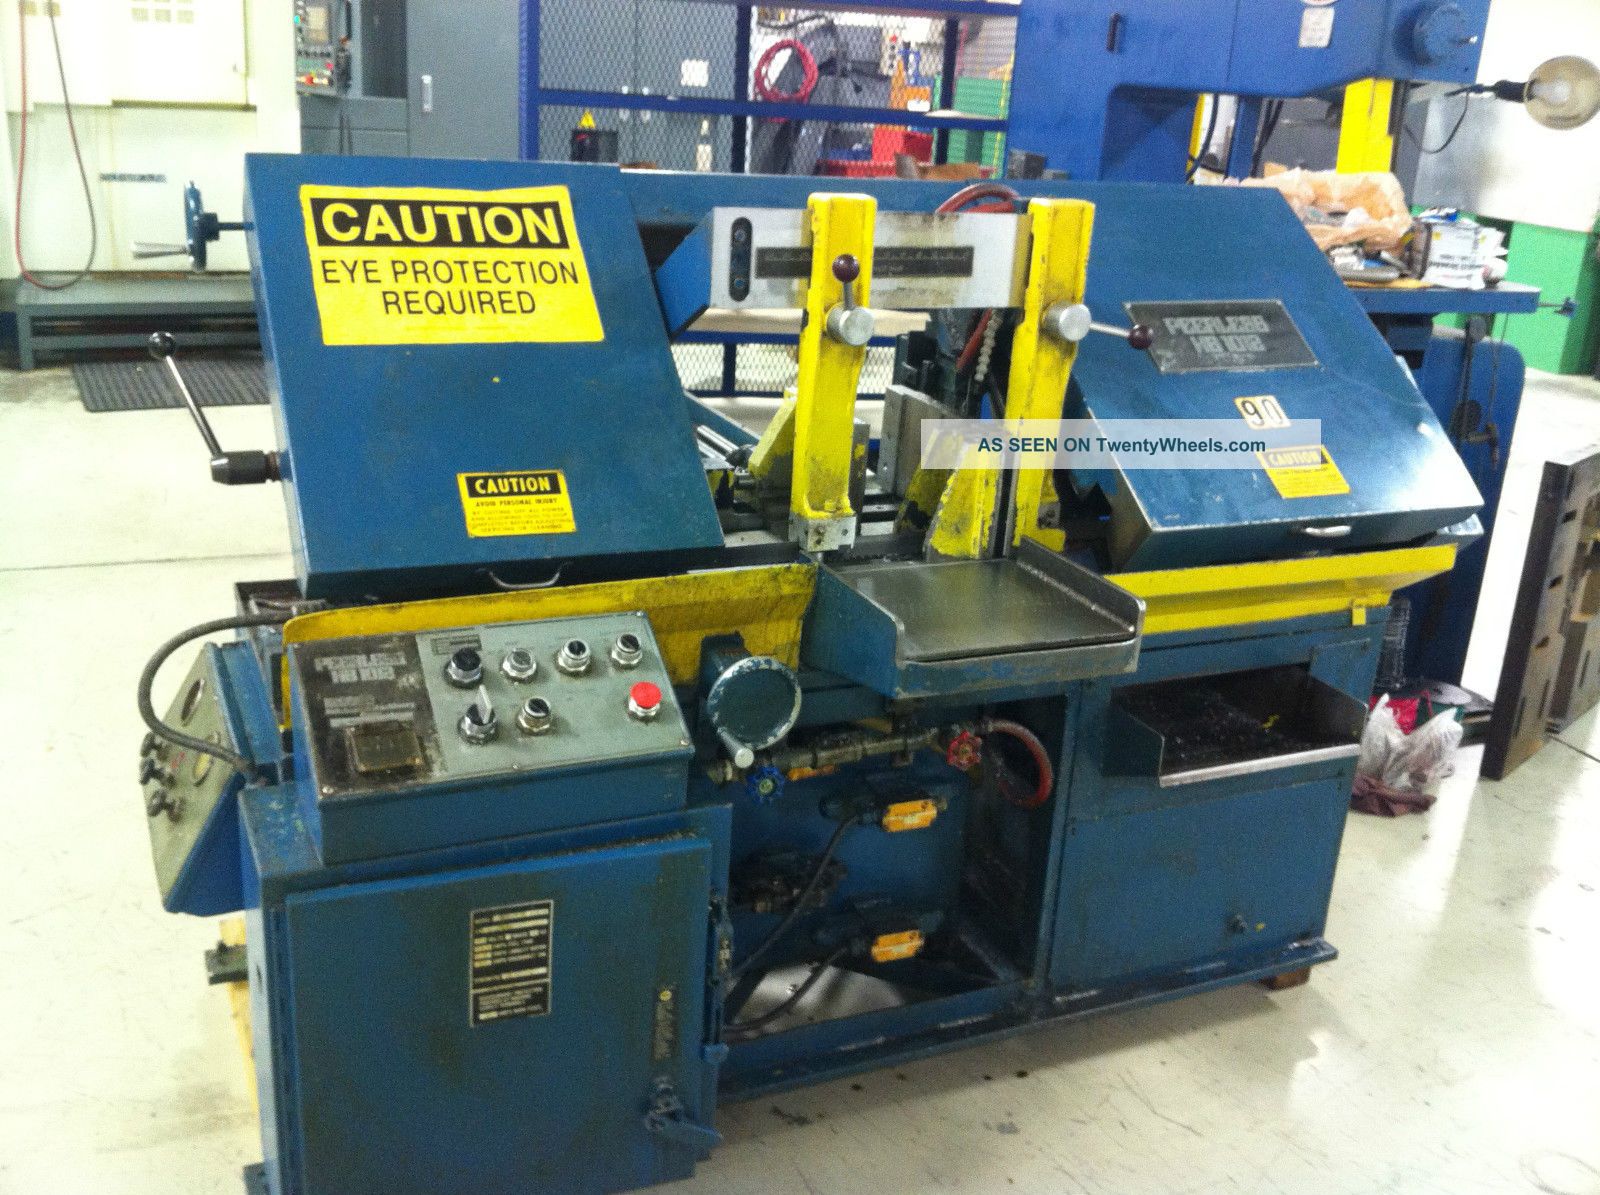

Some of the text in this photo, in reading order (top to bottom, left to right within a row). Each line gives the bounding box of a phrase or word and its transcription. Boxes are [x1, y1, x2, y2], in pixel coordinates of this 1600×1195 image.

[322, 203, 561, 244] CAUTION
[321, 260, 579, 284] EYE PROTECTION
[382, 290, 536, 315] REQUIRED
[1241, 399, 1283, 426] 90
[1267, 450, 1320, 466] CAUTION
[475, 477, 551, 494] CAUTION
[500, 498, 532, 506] PERSONAL
